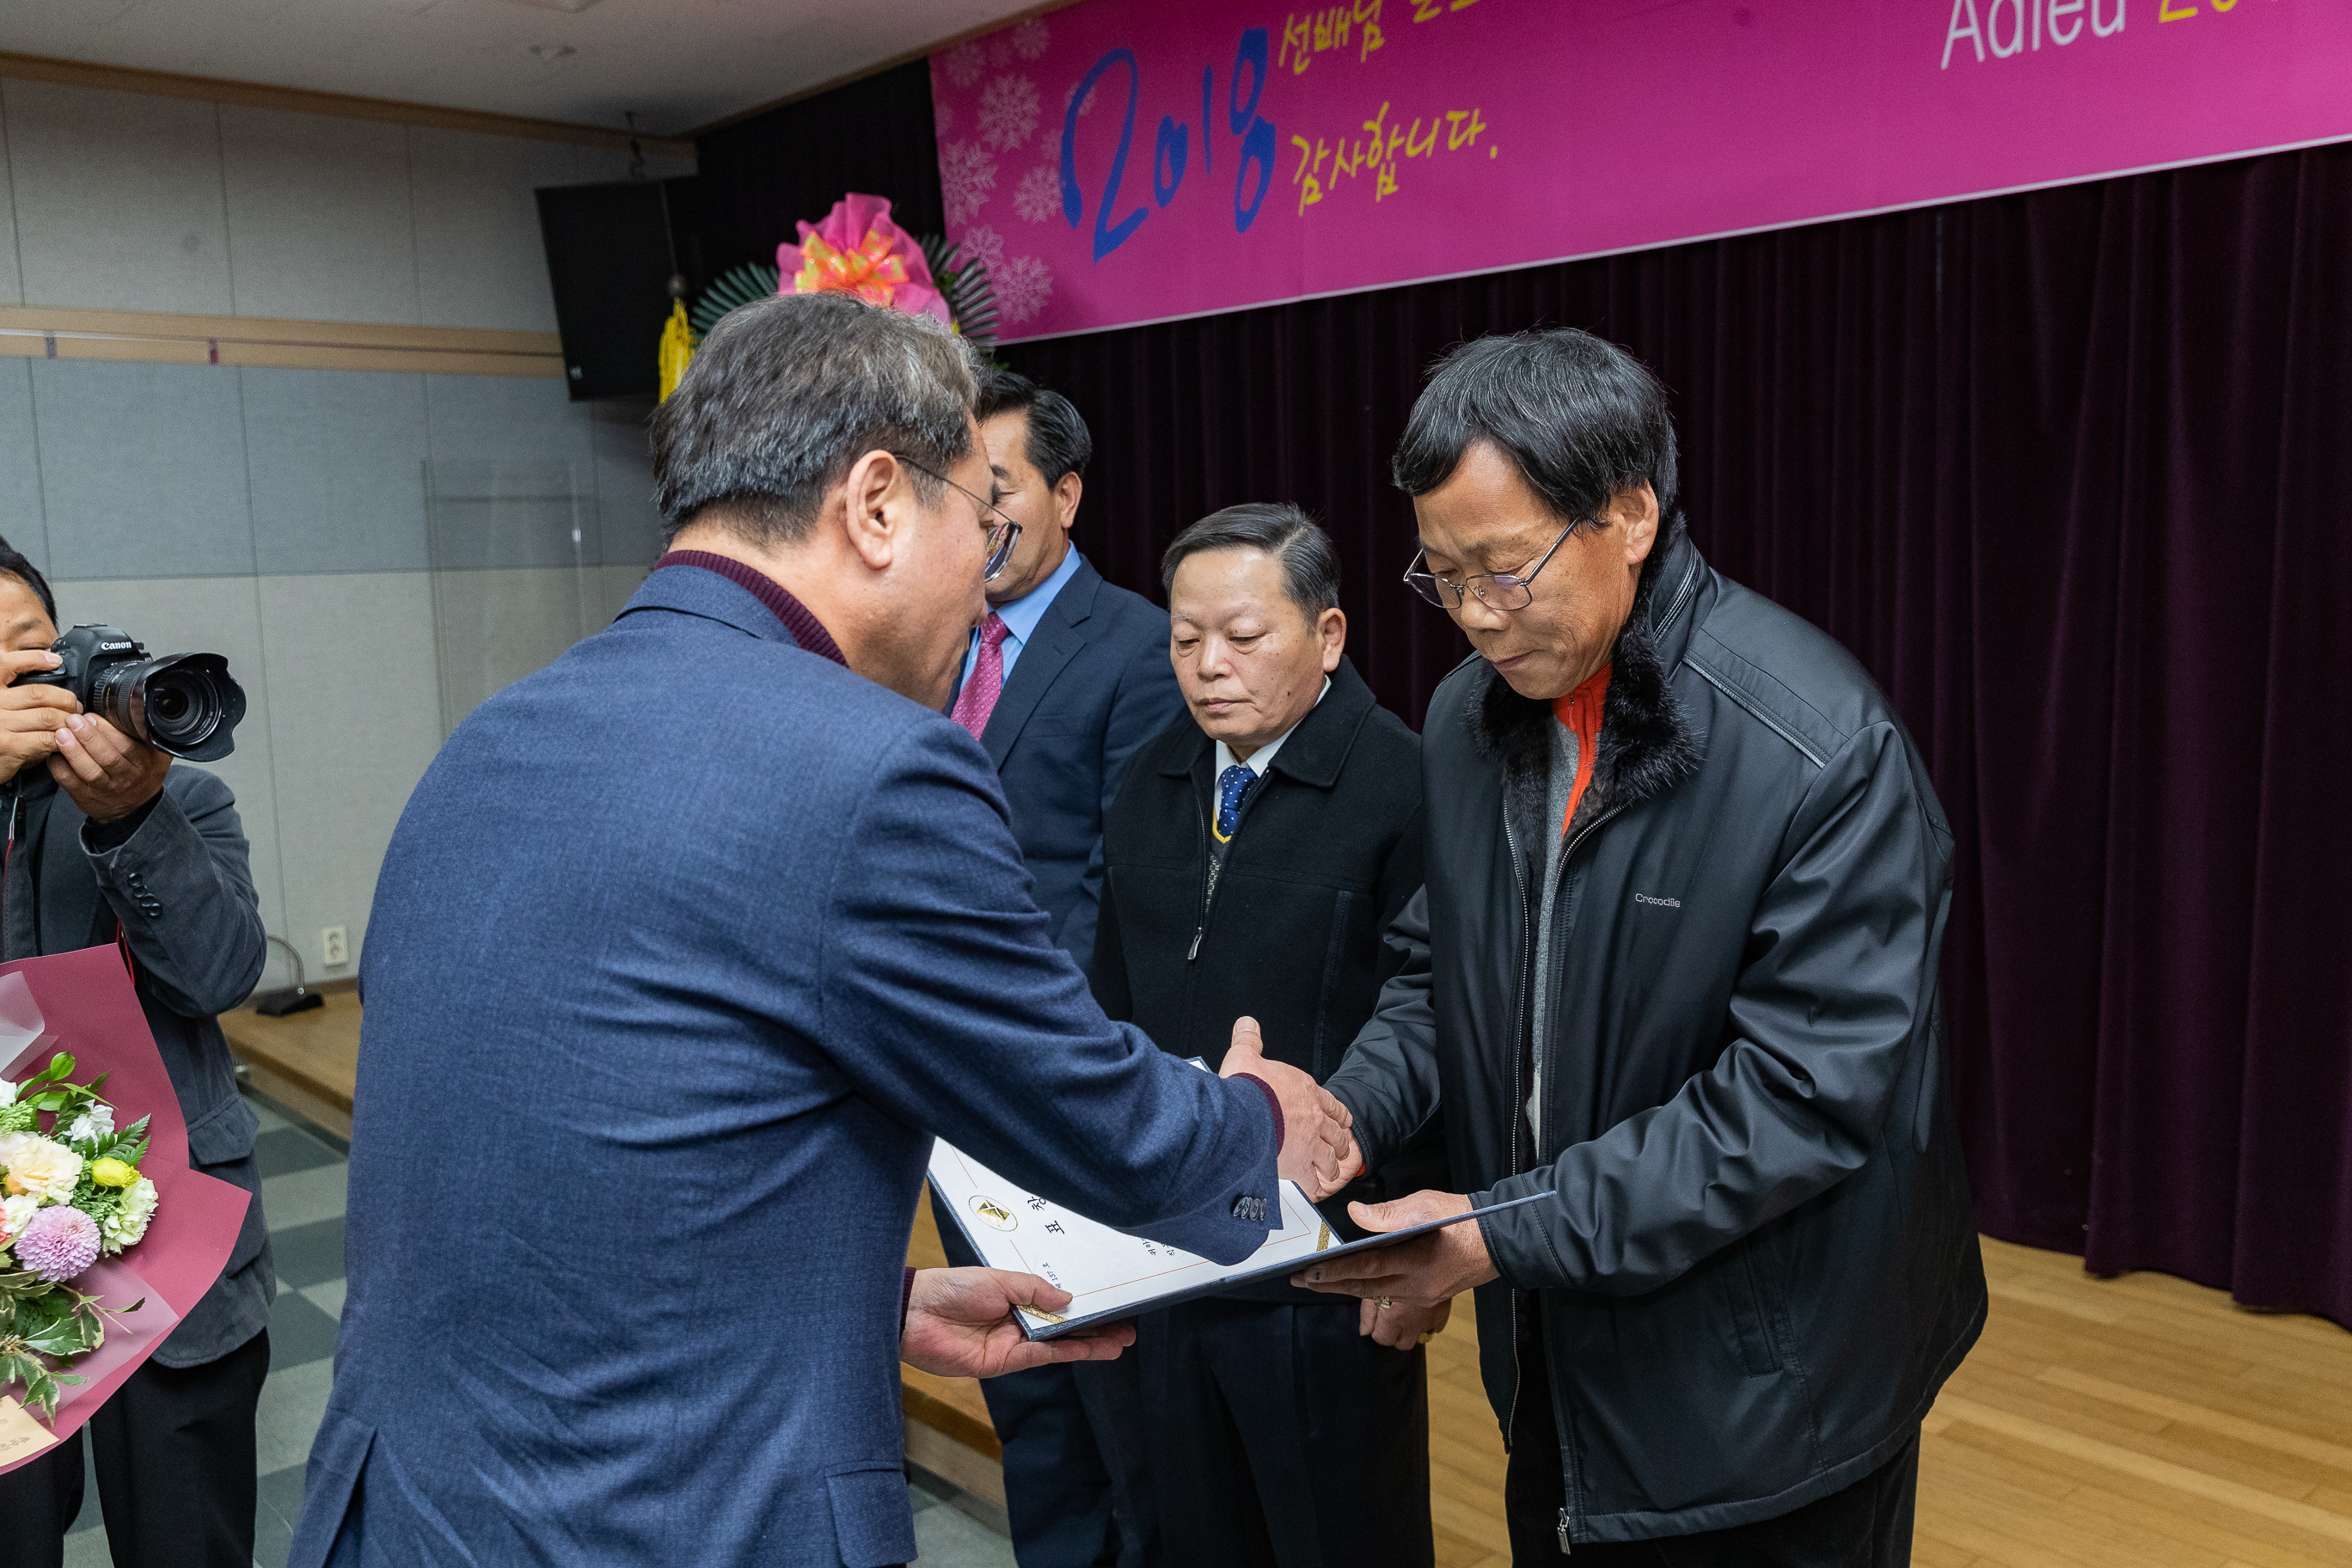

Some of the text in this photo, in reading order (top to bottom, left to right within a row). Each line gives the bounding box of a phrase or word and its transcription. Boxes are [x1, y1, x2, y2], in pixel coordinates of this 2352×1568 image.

[1278, 0, 1386, 76] 선배님
[1059, 27, 1277, 264] 2018
[1291, 101, 1498, 217] 감사합니다.
[101, 641, 132, 651] Canon
[1635, 893, 1681, 908] Crocodile
